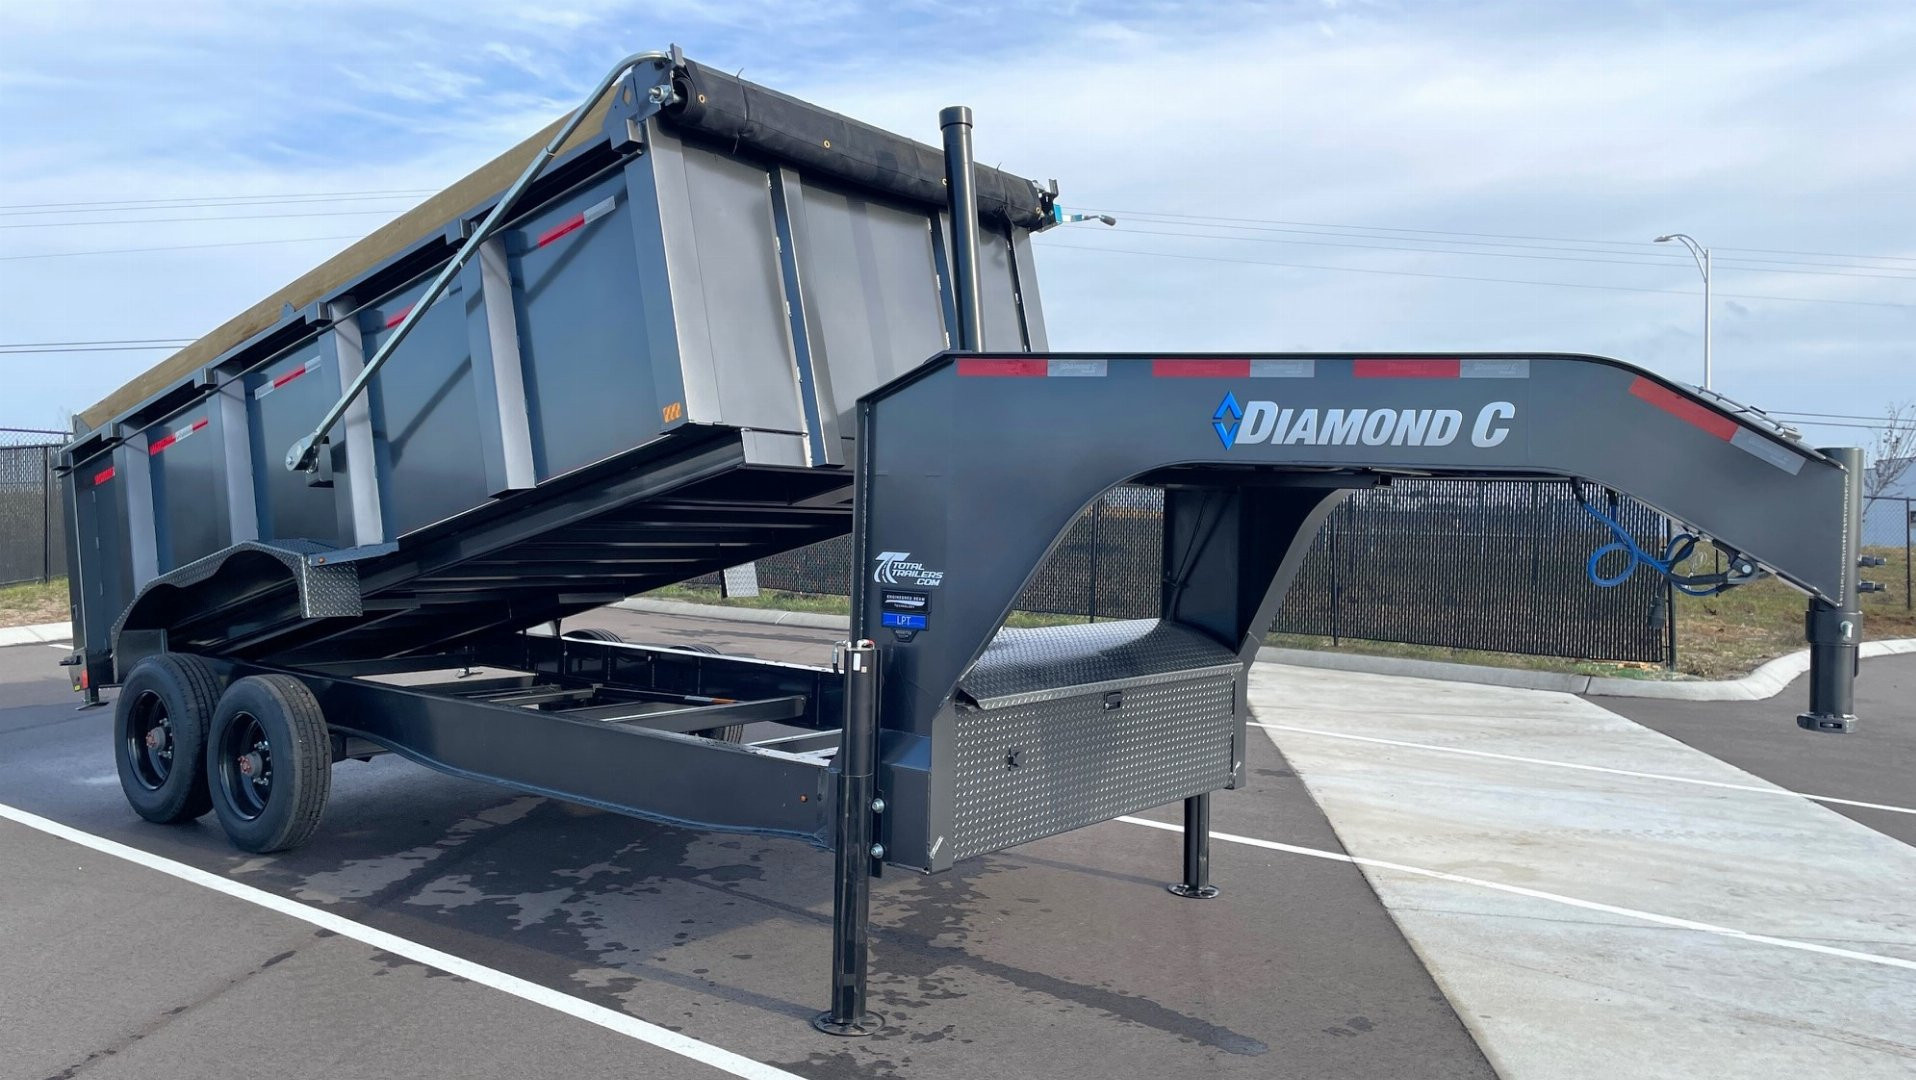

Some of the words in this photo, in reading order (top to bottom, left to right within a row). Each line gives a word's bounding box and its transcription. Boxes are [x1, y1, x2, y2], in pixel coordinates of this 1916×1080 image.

[1234, 401, 1462, 446] DIAMOND
[1471, 401, 1516, 448] C
[893, 562, 925, 570] TOTAL
[891, 569, 944, 579] TRAILERS
[896, 615, 912, 626] LPT
